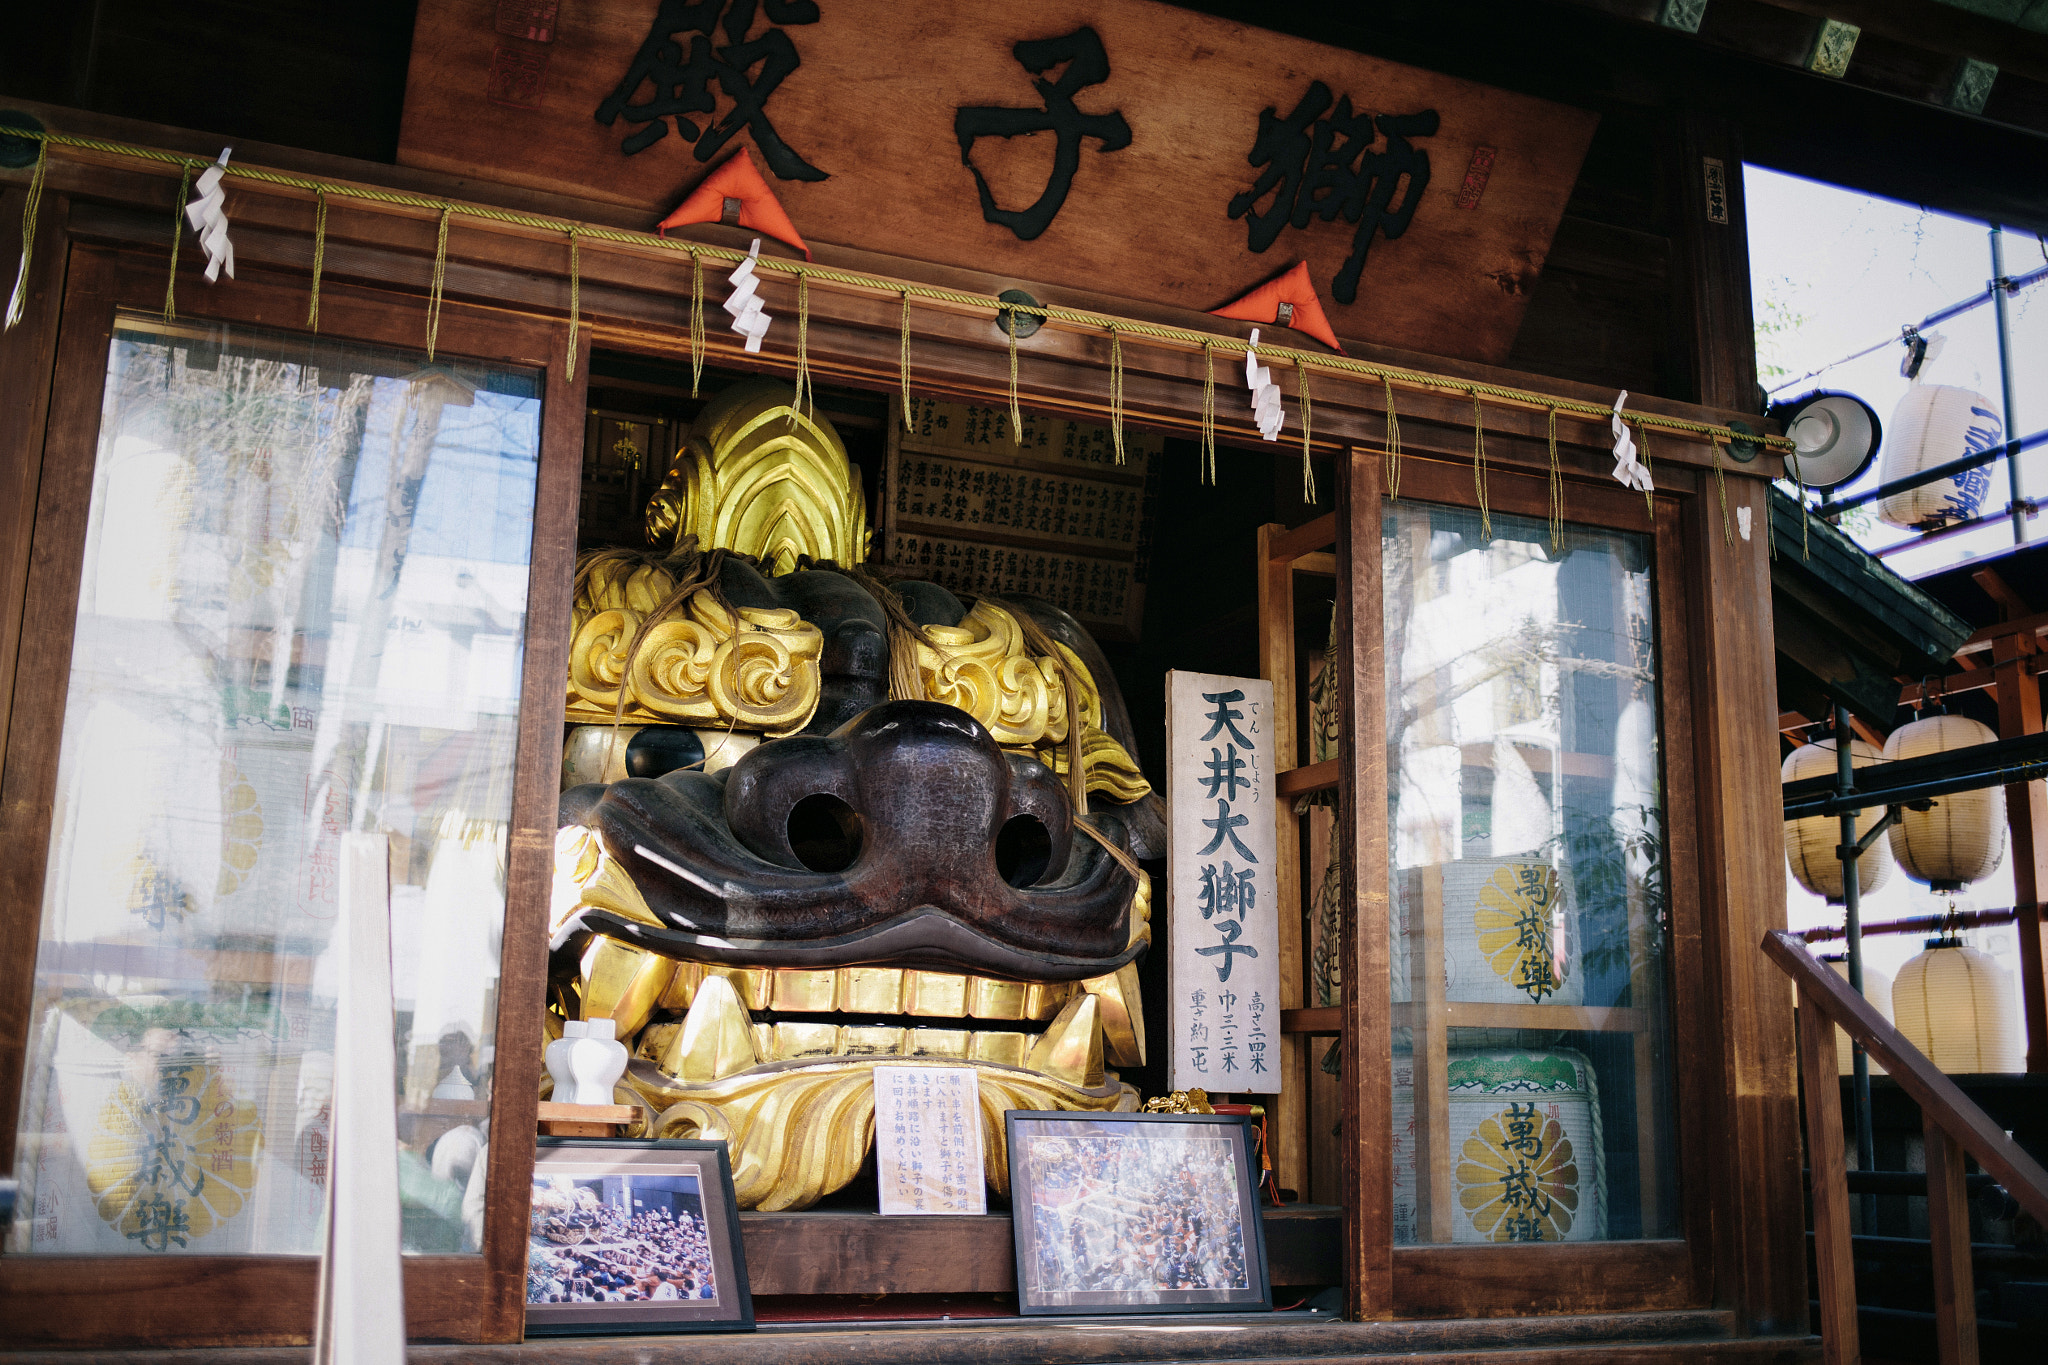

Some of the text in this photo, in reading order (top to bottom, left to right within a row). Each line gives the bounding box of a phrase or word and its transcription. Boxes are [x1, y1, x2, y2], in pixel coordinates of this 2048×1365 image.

[1194, 688, 1259, 982] 天井大獅子
